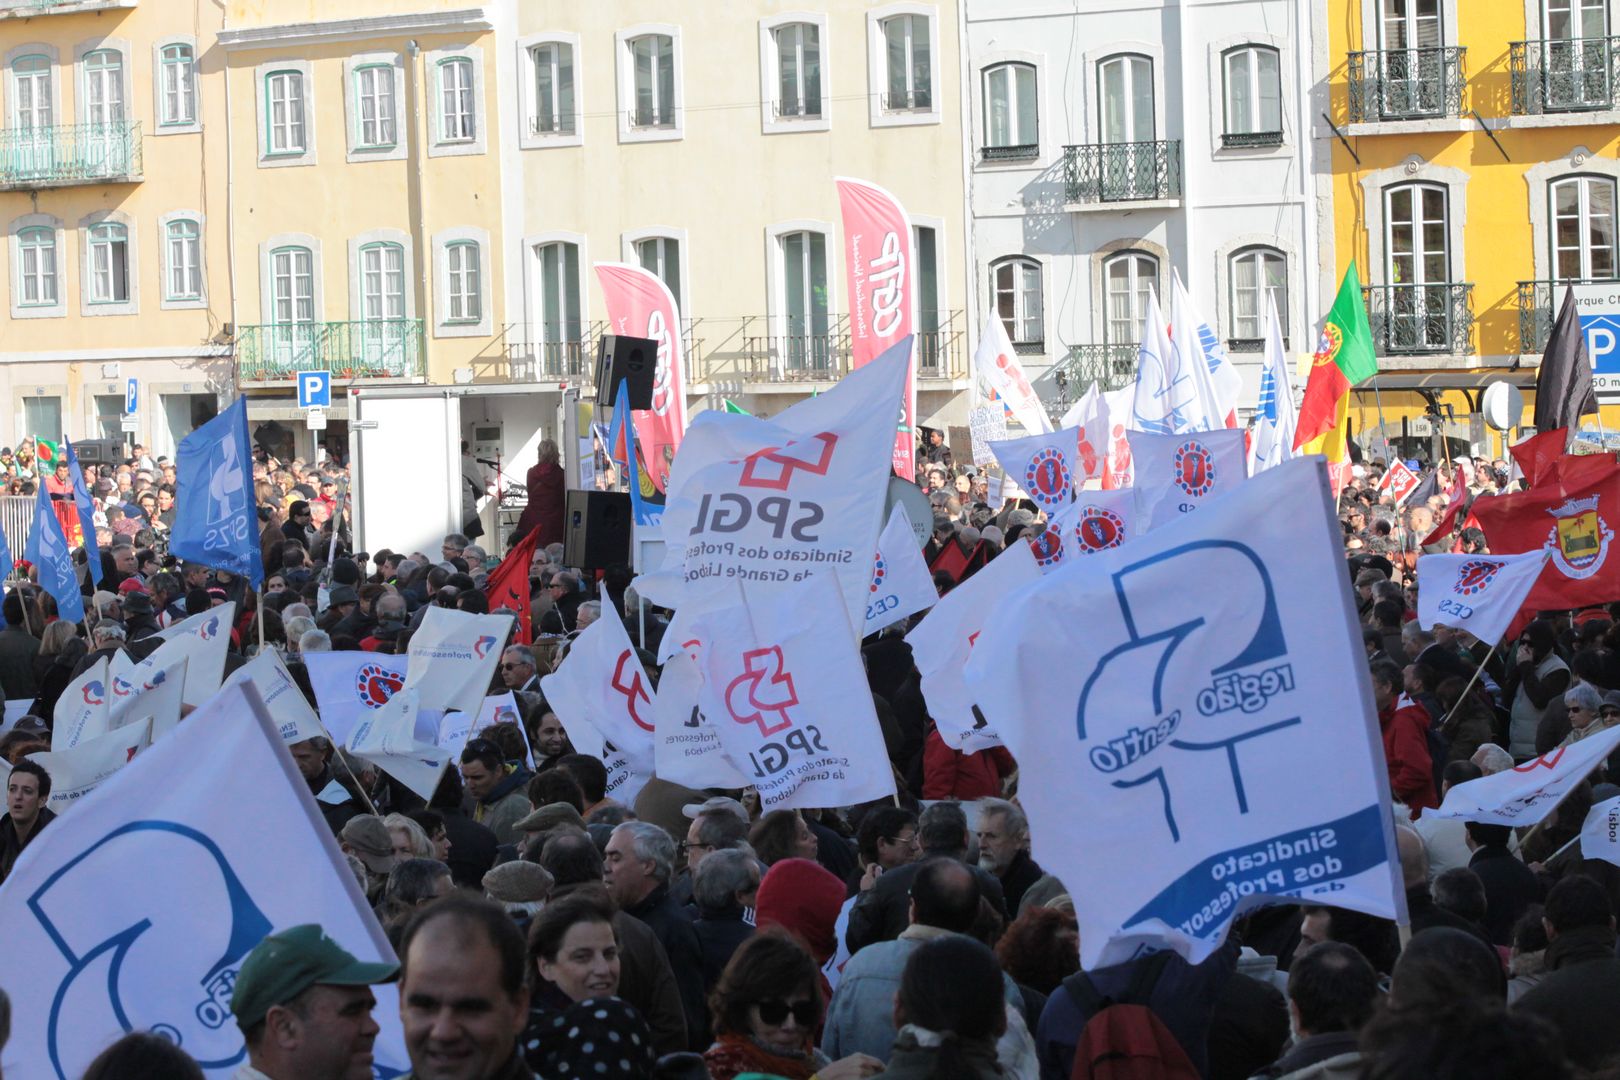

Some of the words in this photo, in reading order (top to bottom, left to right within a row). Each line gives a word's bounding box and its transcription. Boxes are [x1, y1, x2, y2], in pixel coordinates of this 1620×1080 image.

[1574, 296, 1604, 307] arque
[1588, 328, 1616, 369] P
[129, 383, 136, 408] P
[305, 376, 323, 403] P
